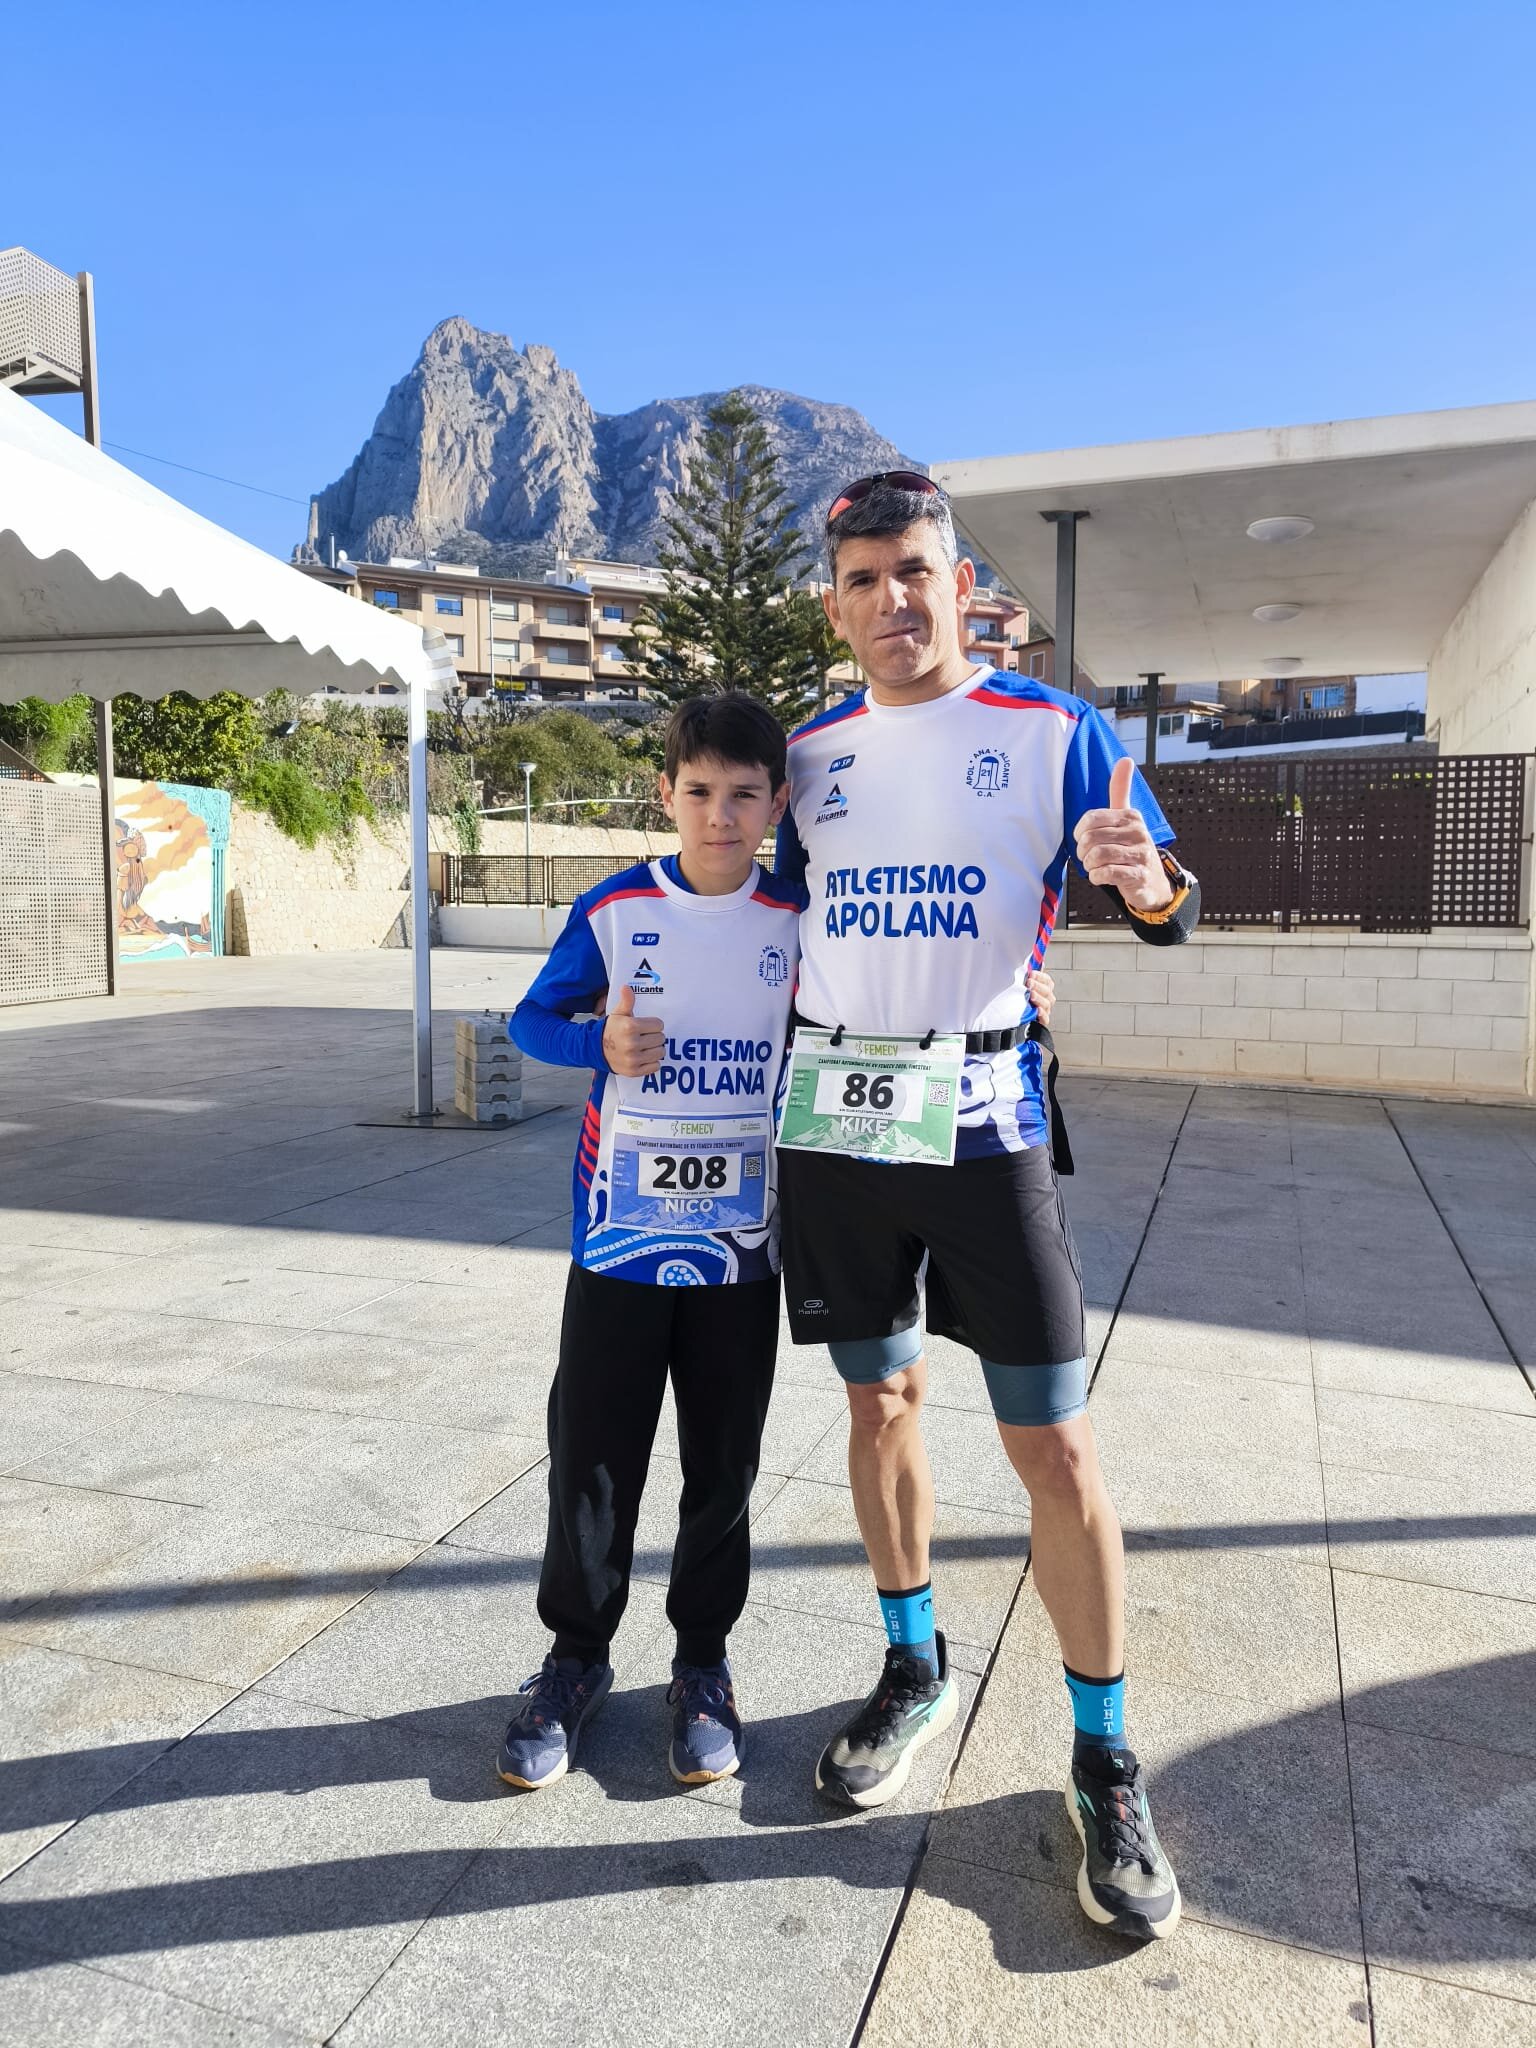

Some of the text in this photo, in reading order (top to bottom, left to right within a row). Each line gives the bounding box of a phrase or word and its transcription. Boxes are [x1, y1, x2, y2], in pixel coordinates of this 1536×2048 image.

[966, 748, 1011, 789] APOL ANA ALICANTE
[980, 768, 991, 778] 21
[814, 809, 849, 825] Alicante
[825, 864, 987, 898] ATLETISMO
[825, 900, 979, 940] APOLANA
[659, 1038, 772, 1063] LETISMO
[864, 1043, 899, 1057] FEMECV
[641, 1065, 765, 1096] APOLANA
[842, 1072, 895, 1110] 86
[681, 1123, 715, 1135] FEMECV
[840, 1116, 889, 1137] KIKE
[652, 1155, 727, 1190] 208
[665, 1198, 714, 1214] NICO
